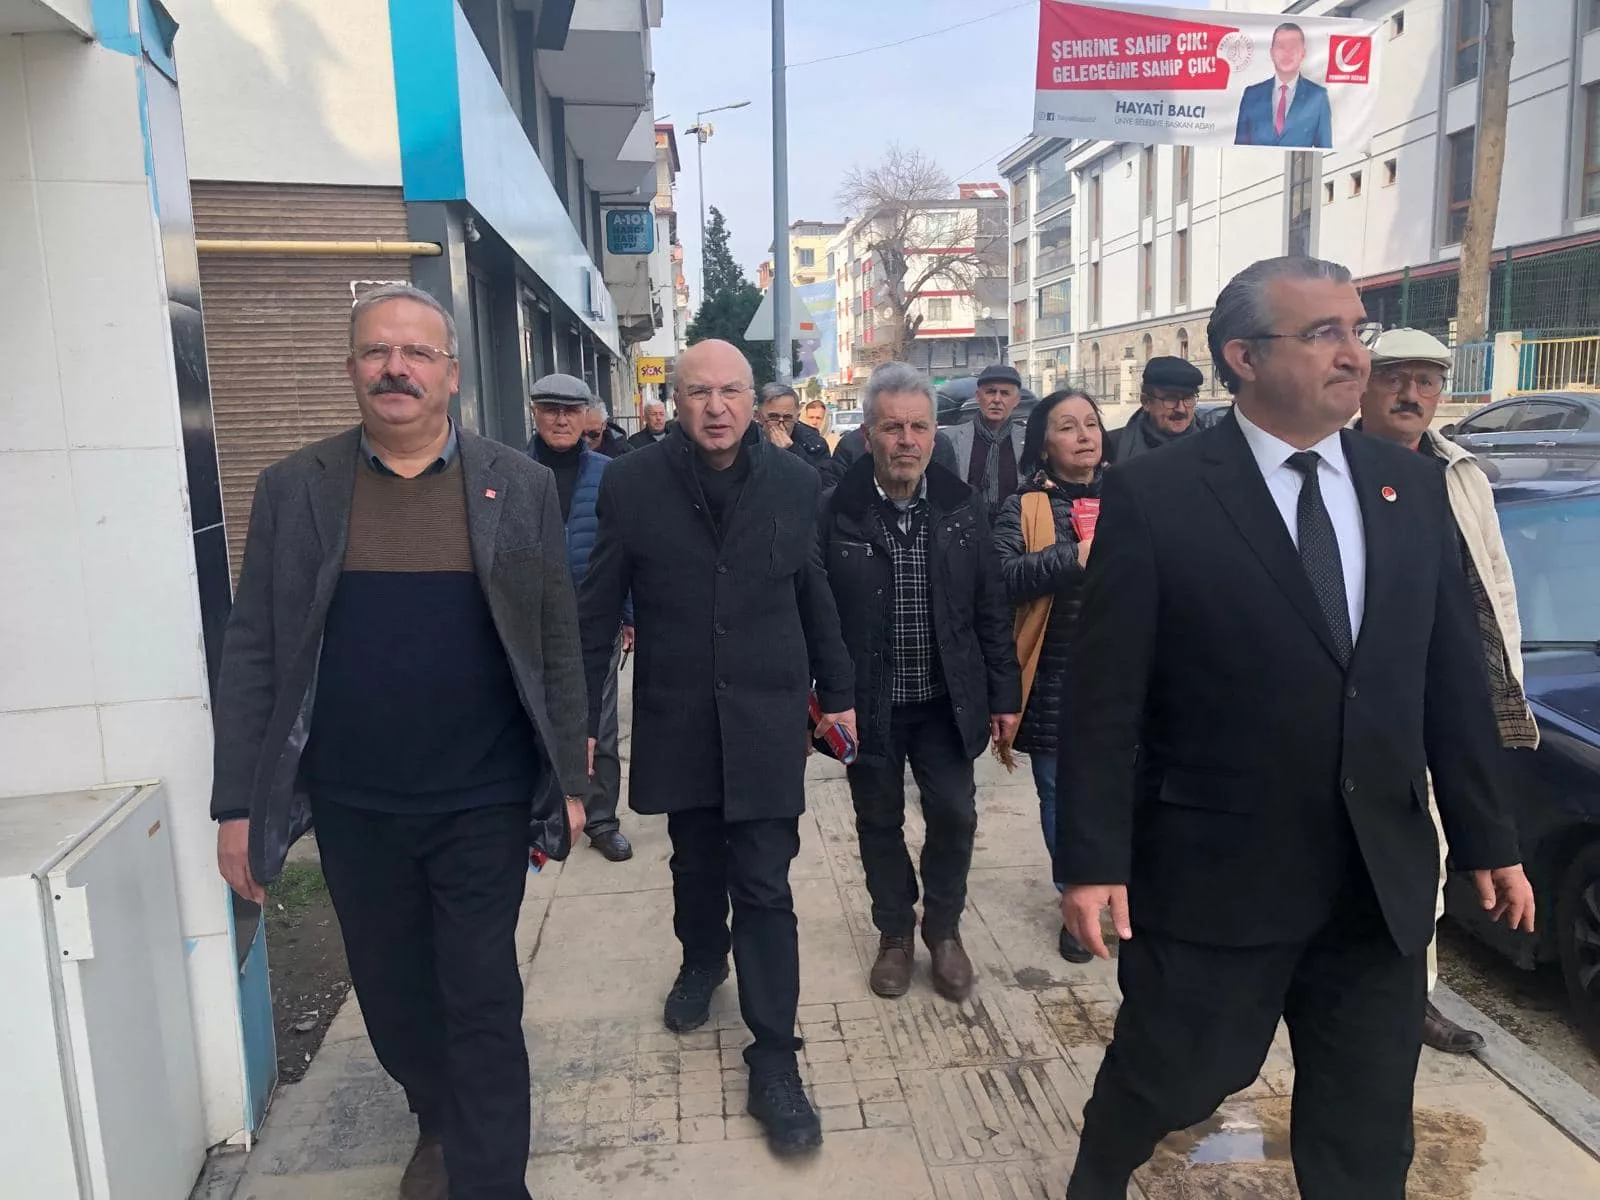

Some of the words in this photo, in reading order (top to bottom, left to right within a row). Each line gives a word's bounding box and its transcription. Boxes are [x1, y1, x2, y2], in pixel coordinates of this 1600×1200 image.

[1051, 38, 1119, 62] ŞEHRİNE
[1125, 34, 1172, 56] SAHİP
[1176, 32, 1208, 54] ÇIK!
[1052, 61, 1139, 83] GELECEĞİNE
[1142, 59, 1183, 78] SAHİP
[1187, 56, 1216, 77] ÇIK!
[1115, 100, 1164, 116] HAYATİ
[1168, 105, 1205, 119] BALCI
